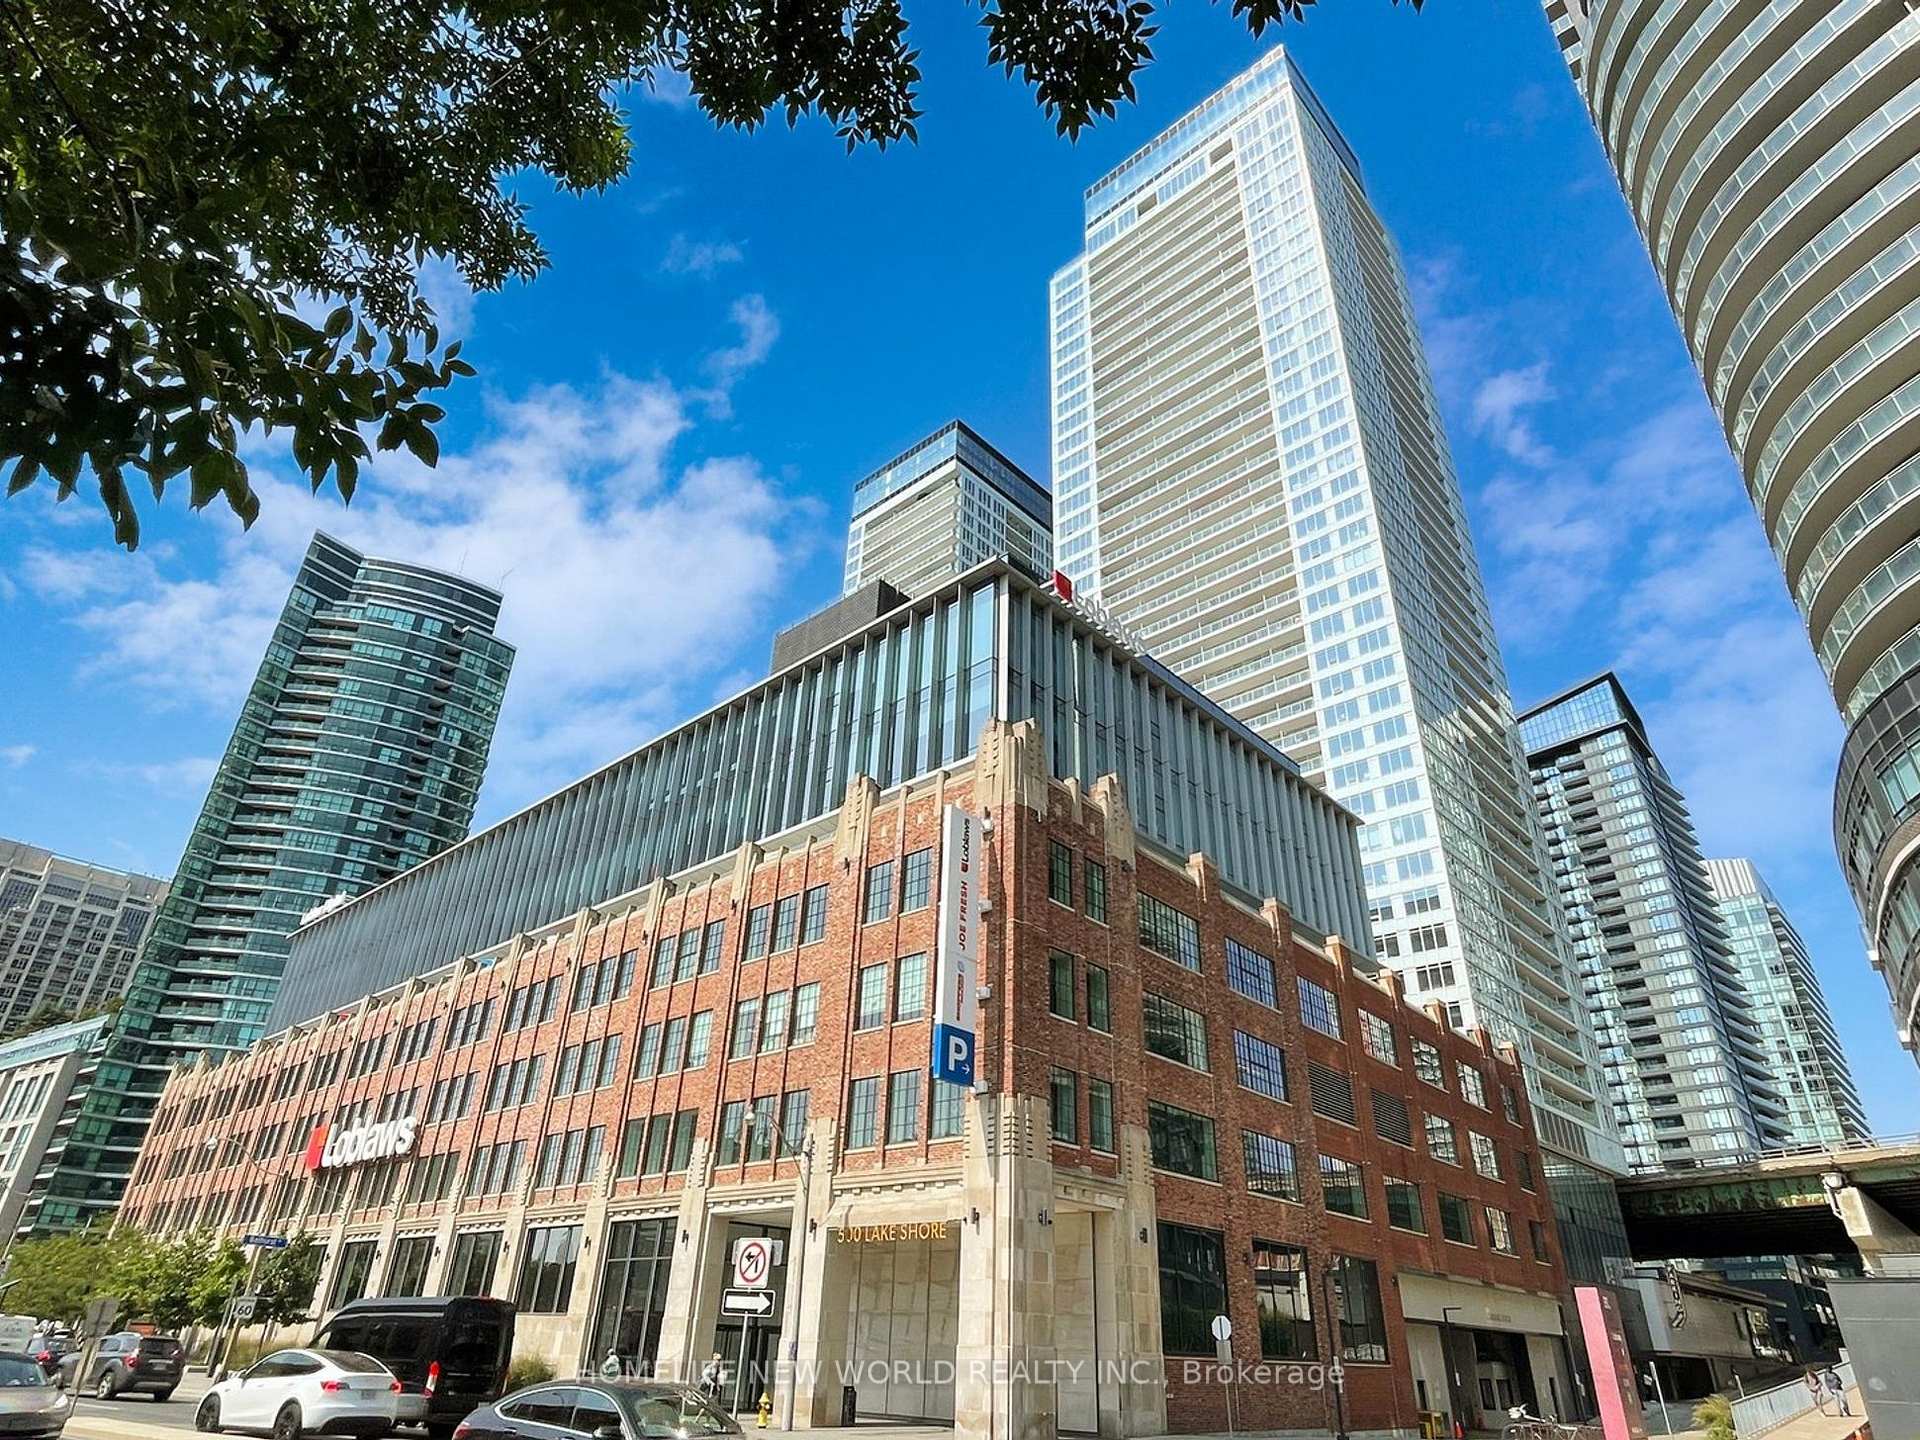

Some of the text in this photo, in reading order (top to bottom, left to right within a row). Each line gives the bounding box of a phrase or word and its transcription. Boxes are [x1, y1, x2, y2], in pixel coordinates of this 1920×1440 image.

[961, 818, 970, 862] Loblaws
[960, 881, 968, 922] FRESH
[948, 1035, 968, 1071] P
[321, 1115, 417, 1167] Loblaws
[864, 1223, 897, 1242] LAKE
[899, 1222, 947, 1241] SHORE
[237, 1304, 253, 1316] 60
